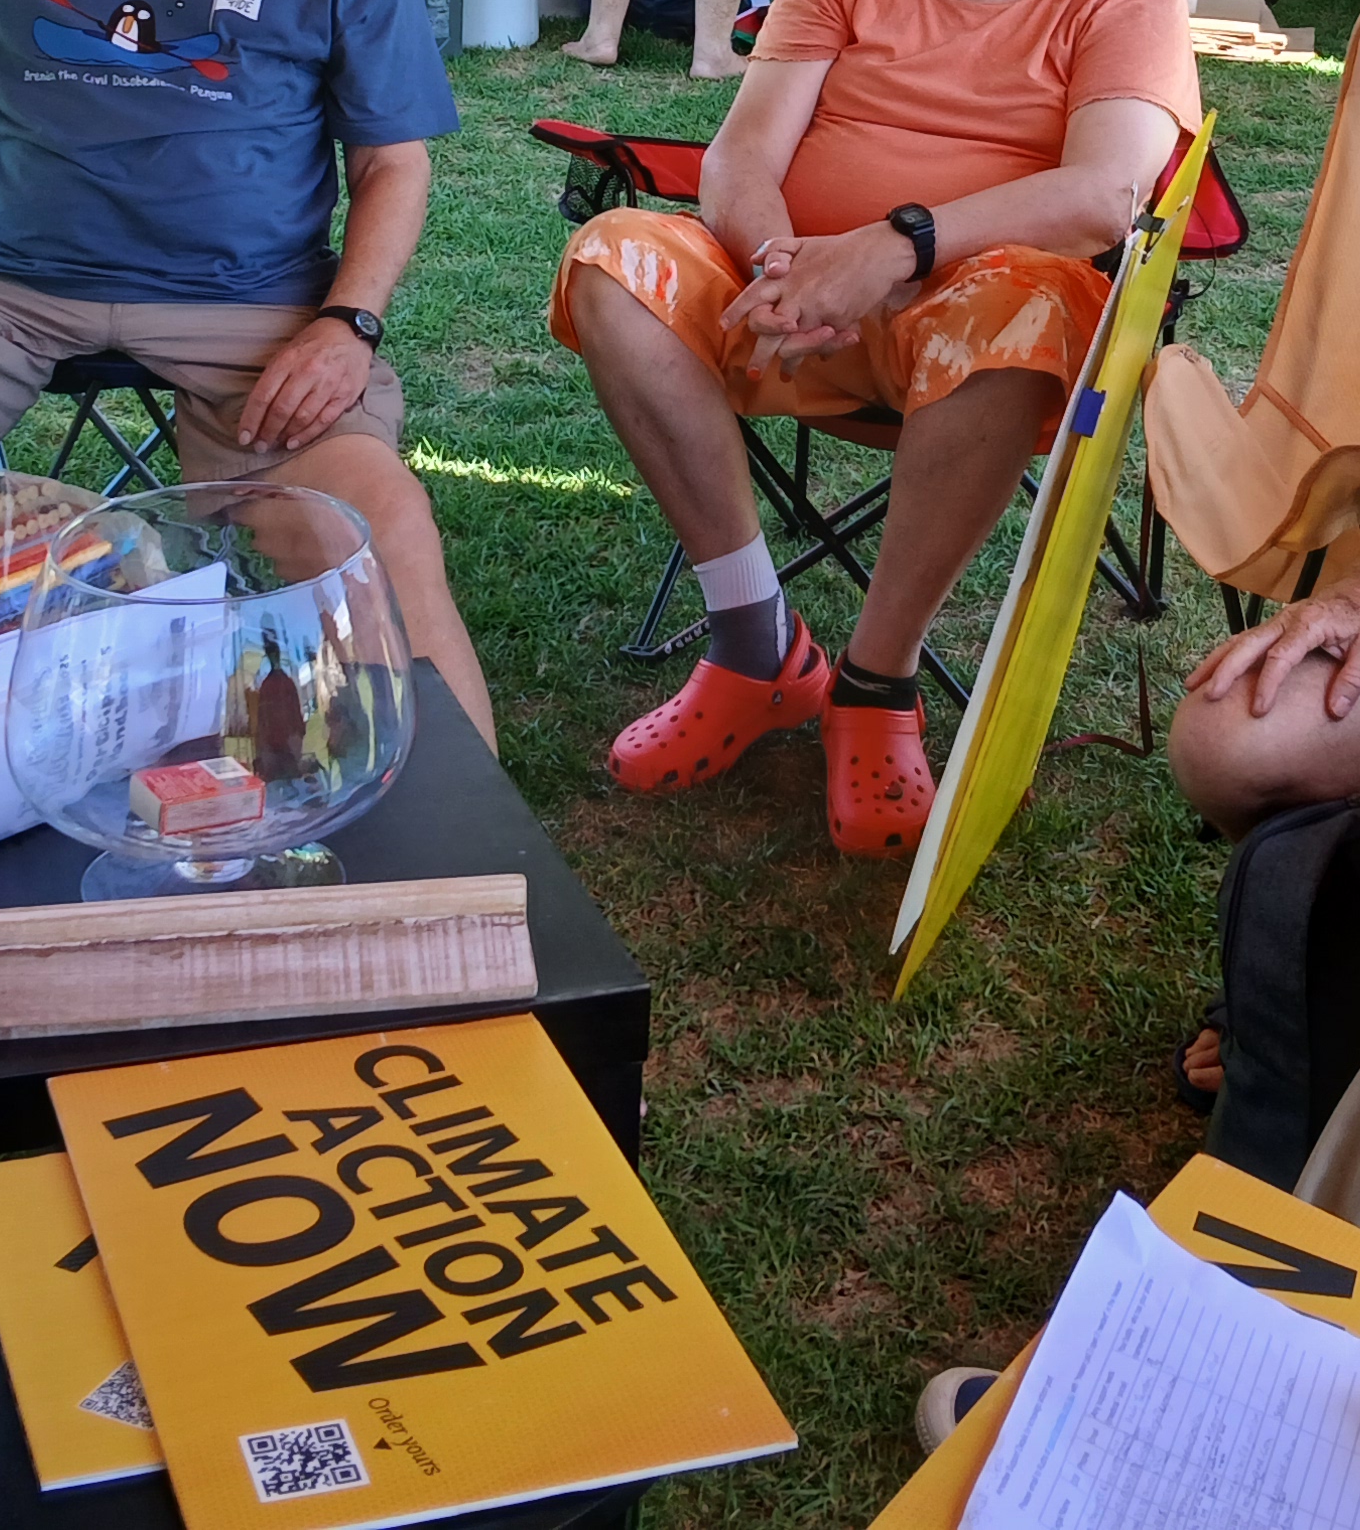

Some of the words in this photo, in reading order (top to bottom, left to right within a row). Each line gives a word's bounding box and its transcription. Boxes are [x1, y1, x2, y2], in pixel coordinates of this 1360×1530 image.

[102, 1086, 487, 1393] NOW
[282, 1106, 586, 1358] ACTION
[353, 1044, 678, 1324] CLIMATE
[368, 1396, 408, 1435] Order
[391, 1435, 442, 1478] yours
